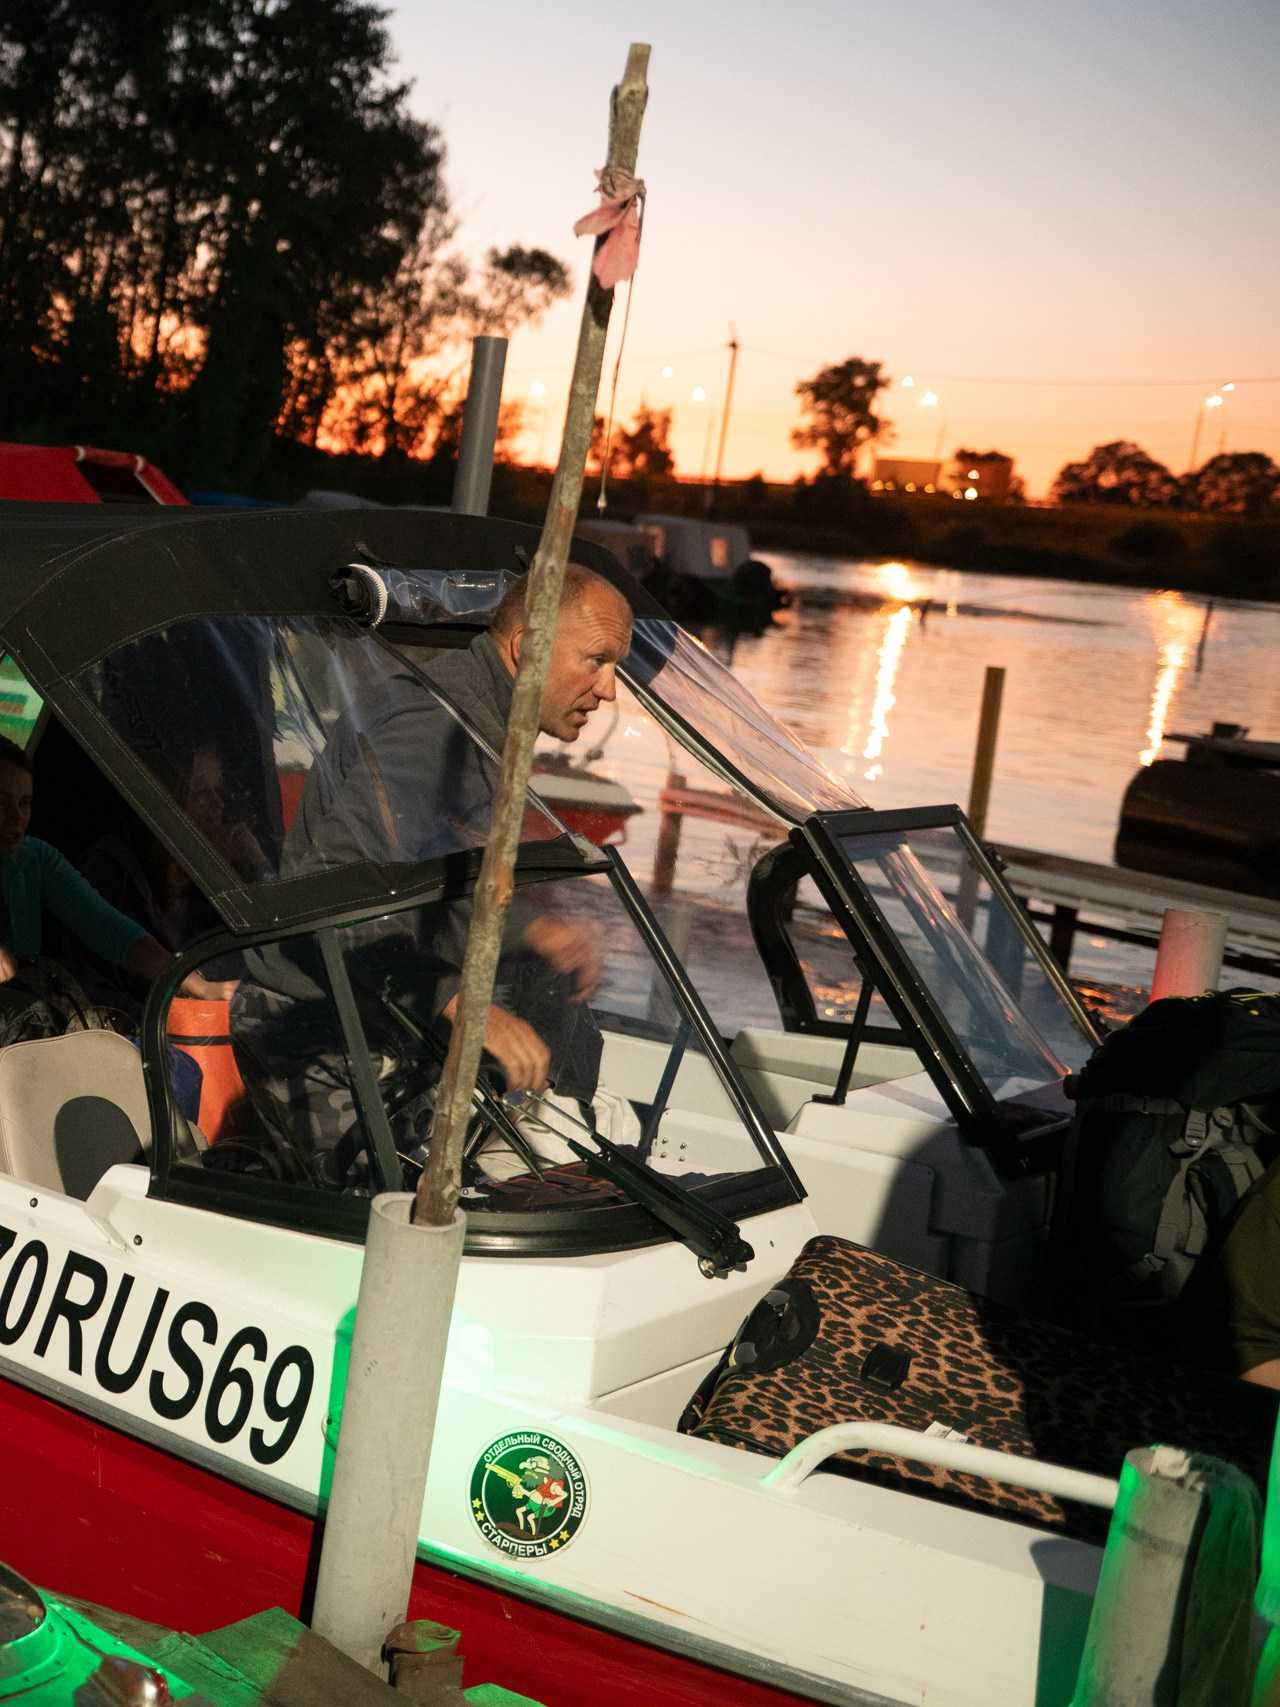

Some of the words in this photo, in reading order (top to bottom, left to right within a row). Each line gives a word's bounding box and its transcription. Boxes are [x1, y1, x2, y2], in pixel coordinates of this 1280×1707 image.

[483, 1433, 540, 1462] ОТДЕЛЬНЫЙ
[541, 1438, 580, 1480] СВОДНЫЙ
[570, 1481, 584, 1518] ОТРЯД
[481, 1522, 547, 1557] СТАРПЕРЫ
